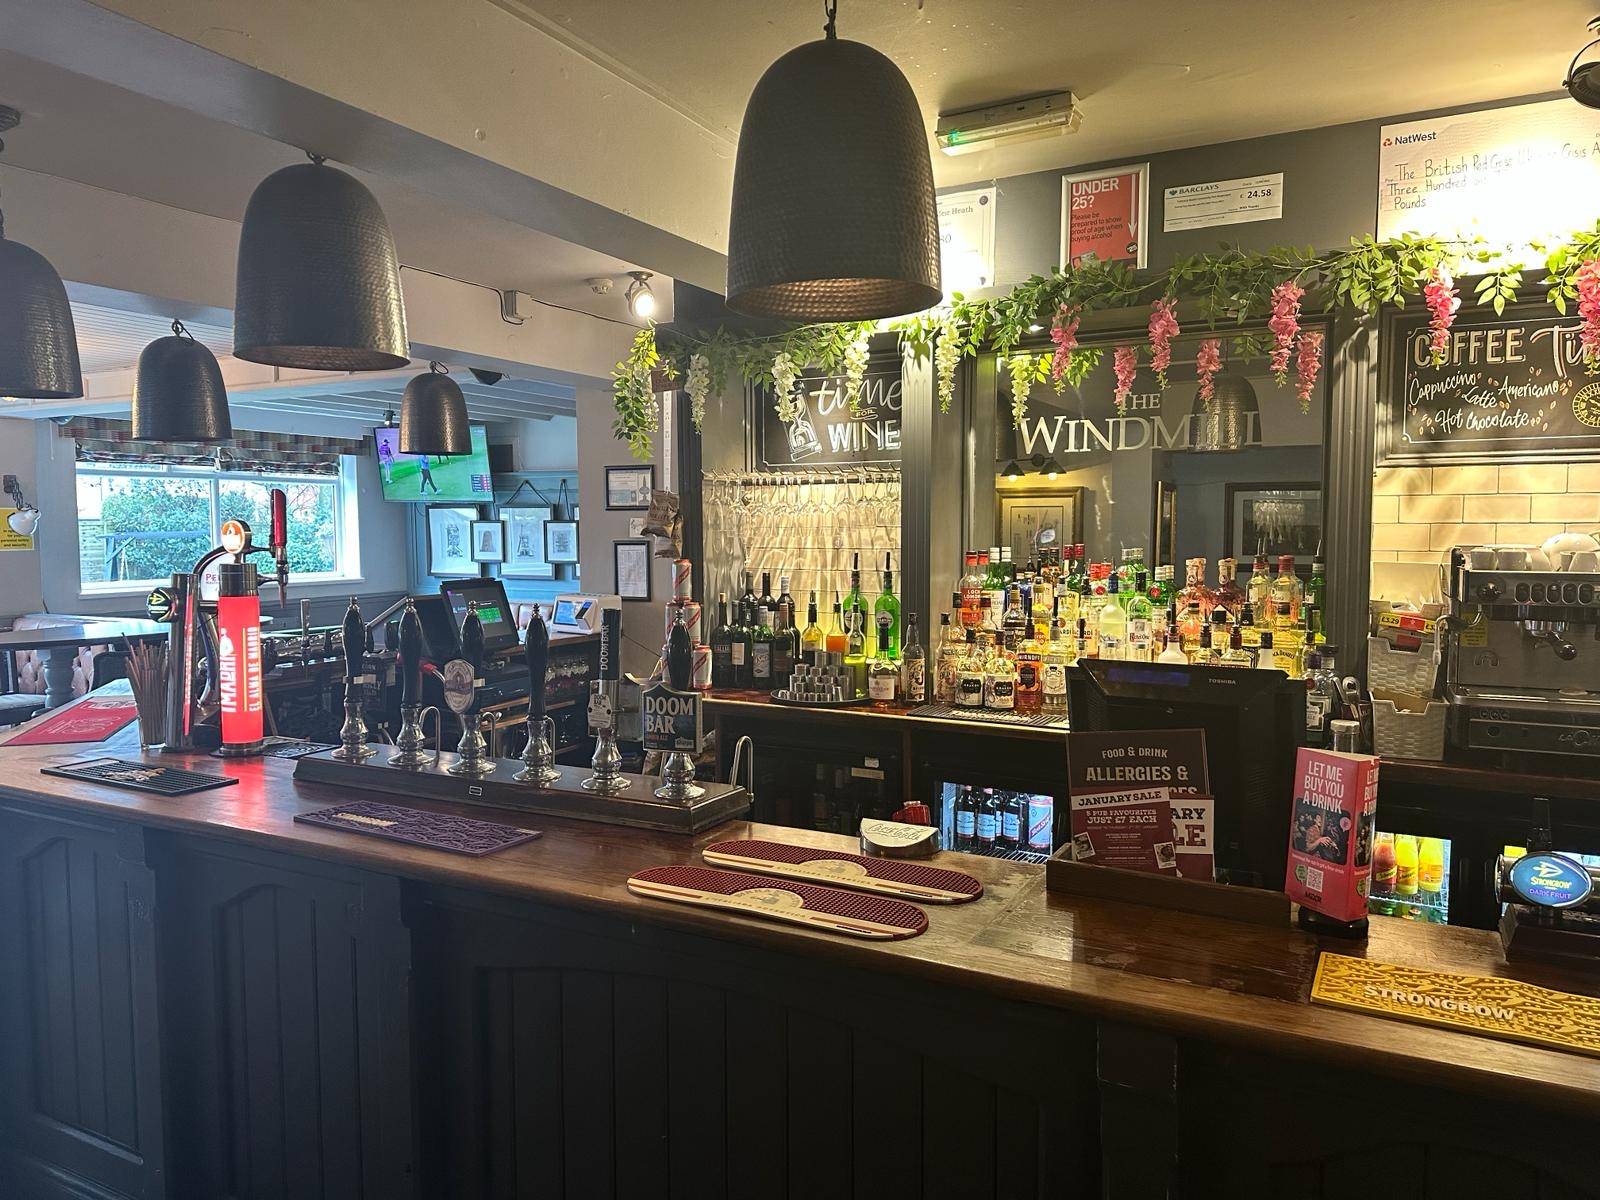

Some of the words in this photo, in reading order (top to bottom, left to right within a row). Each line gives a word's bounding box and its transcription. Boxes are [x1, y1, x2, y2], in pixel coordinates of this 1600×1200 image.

[1394, 131, 1437, 146] NatWest
[1395, 162, 1415, 181] The
[1424, 157, 1468, 179] British
[1072, 177, 1119, 196] UNDER
[1178, 183, 1220, 195] BARCLAYS
[1247, 188, 1272, 199] 24.58
[1387, 182, 1418, 196] Three
[1425, 178, 1468, 193] Hundred
[952, 205, 974, 215] Heath
[1072, 195, 1095, 211] 25?
[1394, 197, 1427, 211] Pounds
[1071, 213, 1091, 221] Please
[1071, 219, 1099, 229] prepared
[1105, 216, 1121, 224] show
[1071, 227, 1086, 236] proof
[1094, 226, 1105, 234] age
[1106, 223, 1123, 231] when
[1091, 232, 1113, 240] alcohol
[1409, 371, 1477, 406] Cappuccino
[1461, 386, 1498, 408] Latte
[1498, 375, 1560, 404] Americano
[1122, 391, 1161, 410] THE
[1435, 408, 1464, 433] Hot
[827, 419, 902, 453] WINE
[1381, 616, 1399, 625] £3.29
[247, 626, 259, 659] MADRID
[645, 696, 694, 716] DOOM
[645, 714, 676, 734] BAR
[1102, 748, 1125, 759] FOOD
[1127, 746, 1135, 757] &
[1138, 747, 1168, 758] DRINK
[1086, 766, 1172, 782] ALLERGIES
[1177, 765, 1189, 781] &
[1308, 760, 1326, 777] LET
[1326, 764, 1343, 782] ME
[1304, 775, 1325, 795] BUY
[1324, 779, 1344, 799] YOU
[1078, 792, 1132, 807] JANUARY
[1133, 791, 1162, 801] SALE
[1303, 791, 1310, 805] A
[1311, 794, 1343, 815] DRINK
[1087, 816, 1112, 824] JUST
[1115, 815, 1126, 824] £7
[1129, 815, 1157, 823] EACH
[1530, 876, 1573, 889] STRONGBOW
[1529, 888, 1549, 898] DARK
[1550, 891, 1572, 899] FRUIT
[1363, 985, 1515, 1021] STRONGBOW
